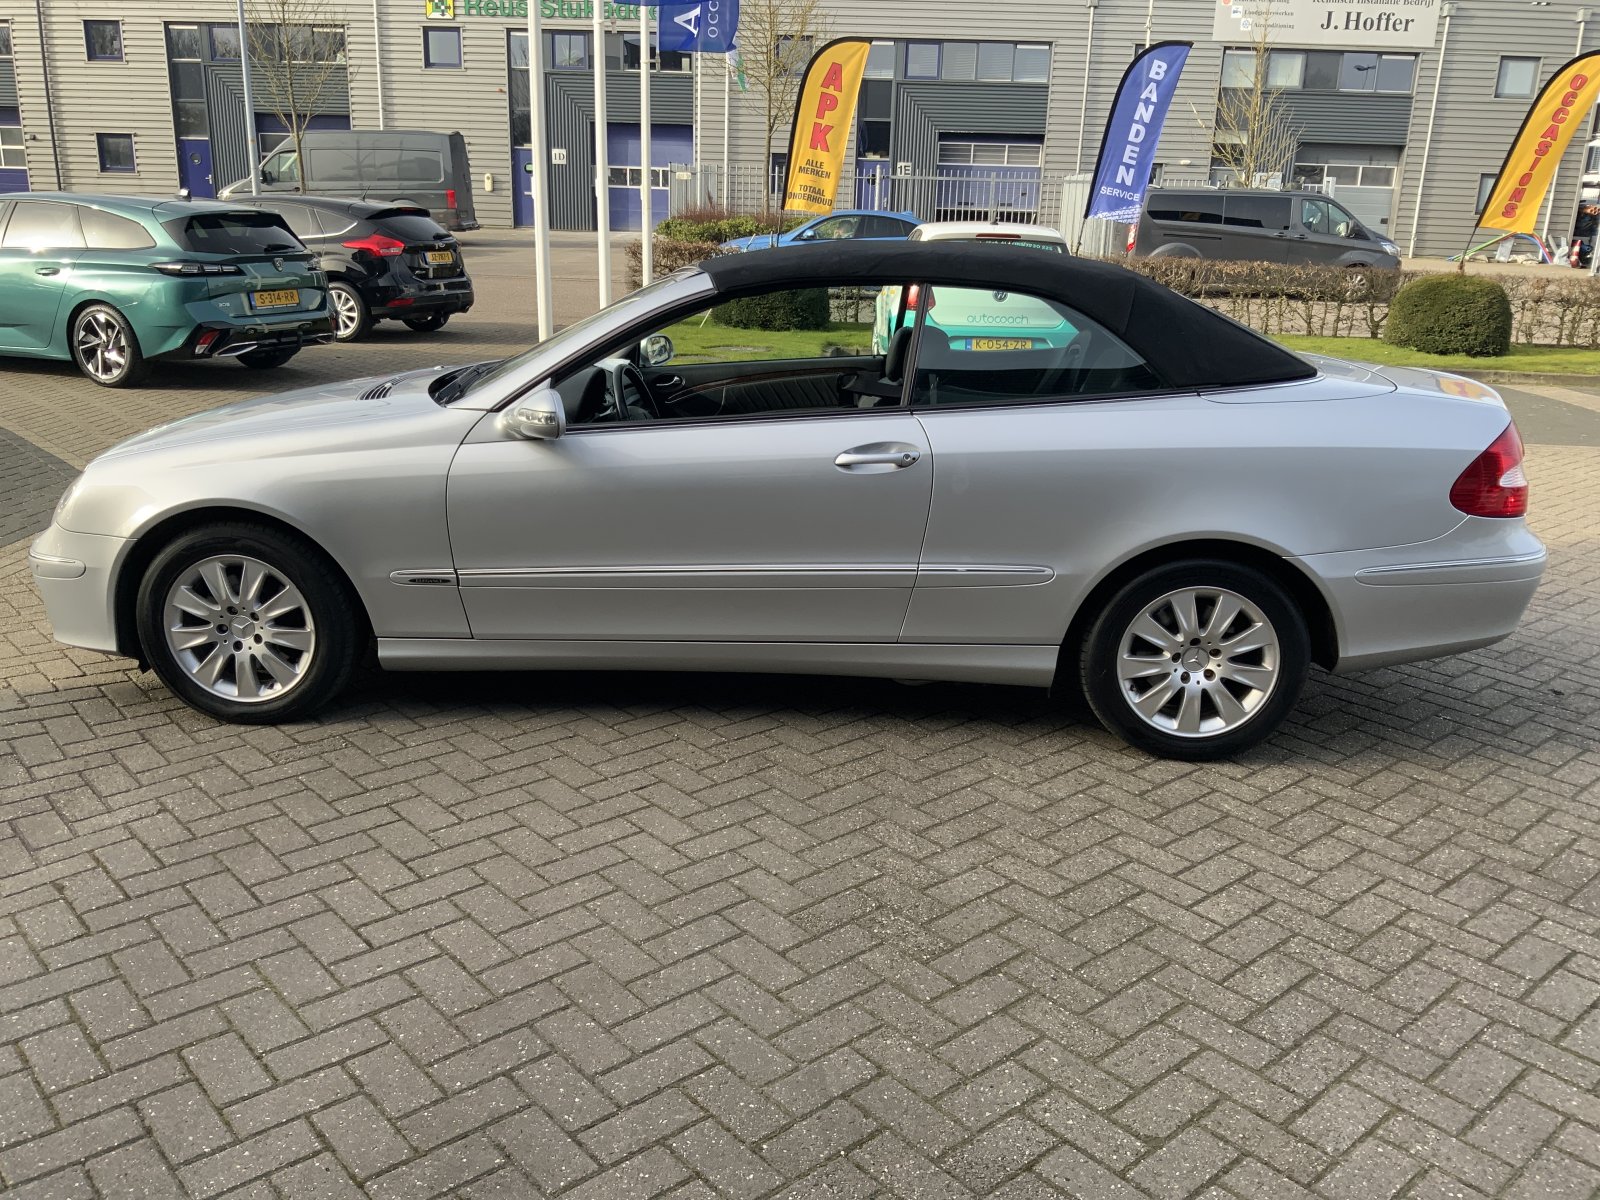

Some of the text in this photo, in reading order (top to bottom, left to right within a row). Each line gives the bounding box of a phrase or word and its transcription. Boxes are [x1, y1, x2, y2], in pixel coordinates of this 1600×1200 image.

[1320, 10, 1415, 32] J. Hoffer
[810, 61, 843, 153] APK
[1115, 59, 1168, 187] BANDEN
[1501, 73, 1589, 219] OCCASIONS
[553, 152, 566, 161] 1D
[805, 158, 825, 170] ALLE
[897, 165, 911, 176] 1E
[798, 165, 831, 180] MERKEN
[799, 184, 826, 197] TOTAAL
[1100, 186, 1140, 202] SERVICE
[788, 191, 833, 207] ONDERHOUD
[259, 291, 296, 305] S-314-RR
[966, 313, 1030, 325] autocoach
[975, 339, 1028, 350] K-054-ZR
